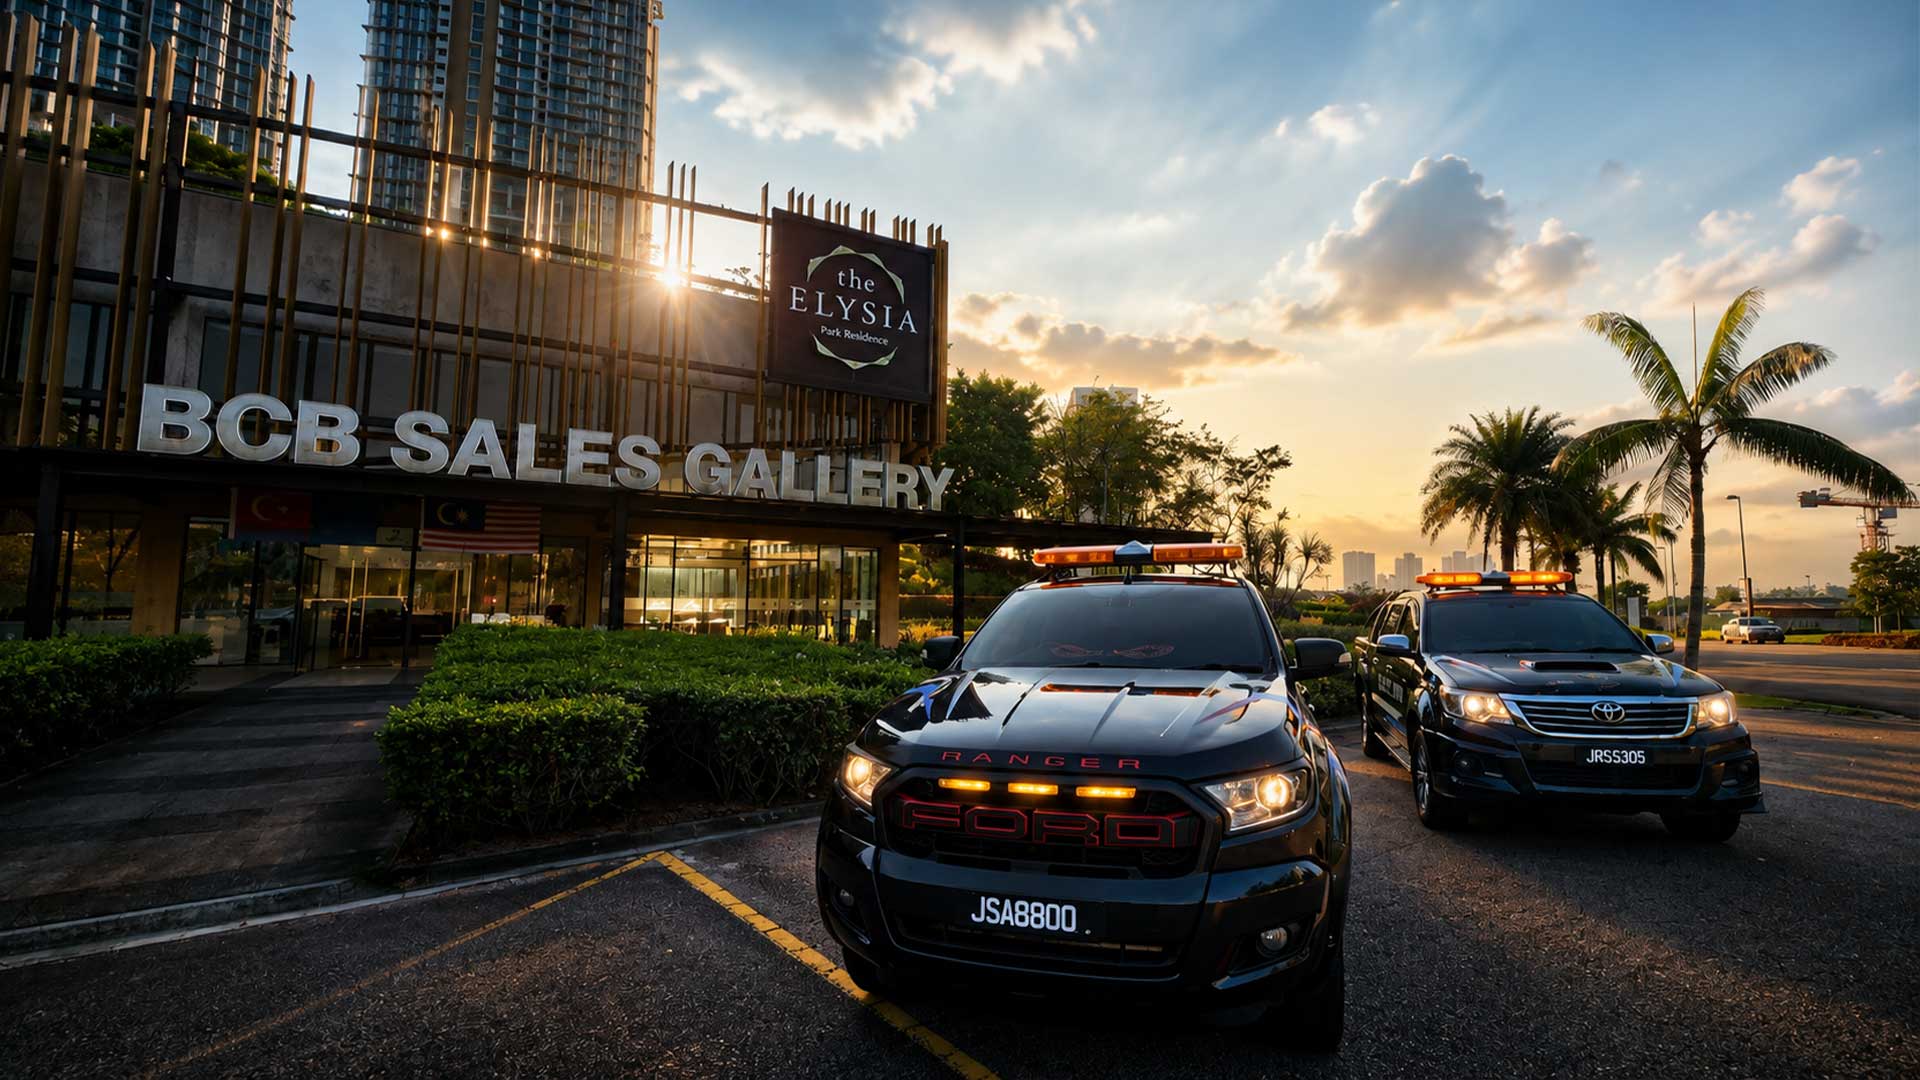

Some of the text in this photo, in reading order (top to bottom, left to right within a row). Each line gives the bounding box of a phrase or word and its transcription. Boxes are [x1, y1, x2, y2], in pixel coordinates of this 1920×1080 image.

[838, 268, 875, 293] the
[789, 285, 918, 334] ELYSIA
[821, 325, 889, 346] Park Residence
[137, 383, 955, 512] BCB SALES GALLERY
[942, 751, 1141, 770] RANGER
[902, 800, 1176, 849] FORD
[971, 896, 1077, 932] JSA8800
